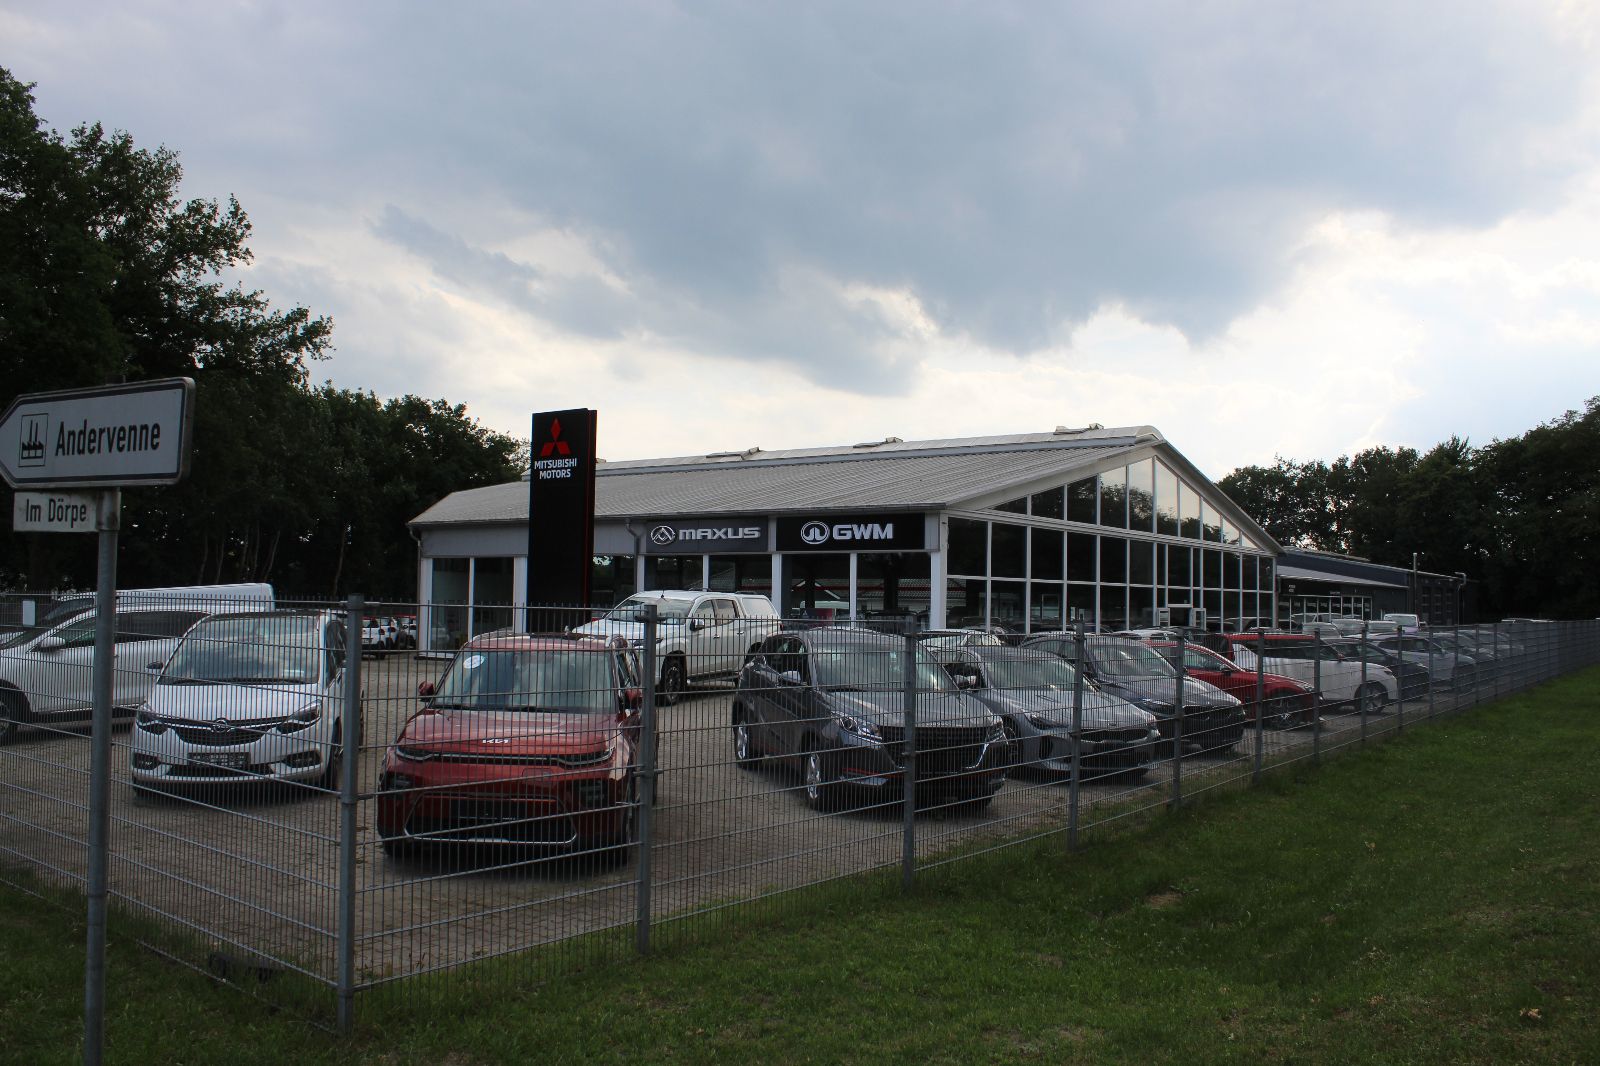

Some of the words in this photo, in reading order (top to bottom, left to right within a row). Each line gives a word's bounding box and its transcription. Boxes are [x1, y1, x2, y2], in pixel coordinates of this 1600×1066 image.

[55, 419, 161, 456] Andervenne
[534, 458, 577, 470] MITSUBISHI
[539, 469, 571, 479] MOTORS
[25, 499, 41, 522] Im
[48, 498, 87, 528] Dörpe
[832, 523, 894, 540] GWM
